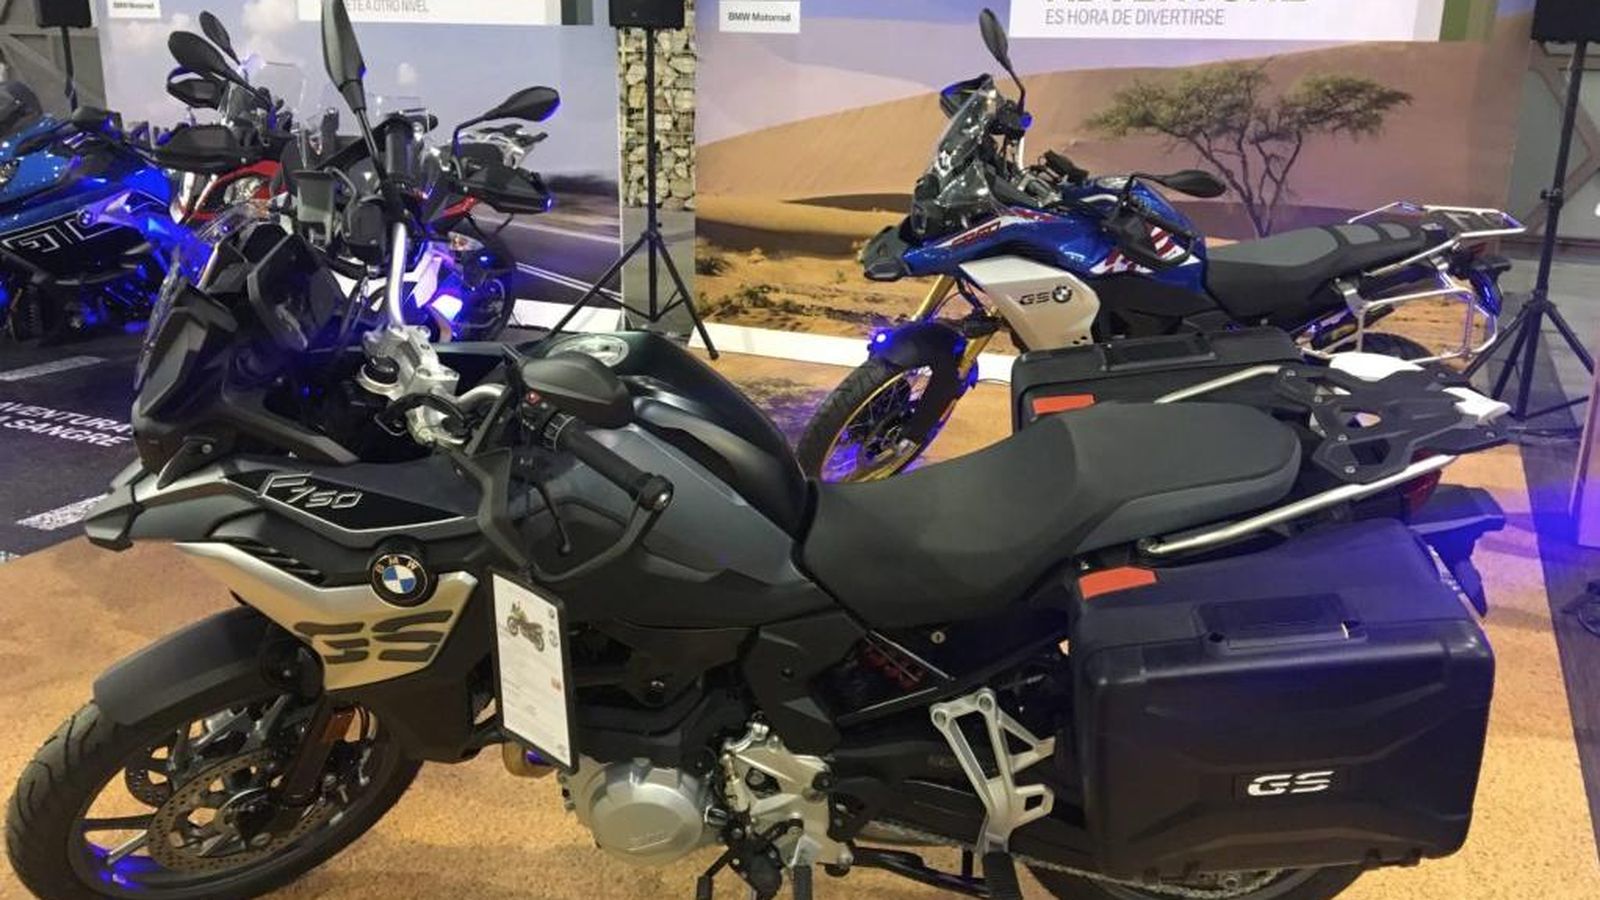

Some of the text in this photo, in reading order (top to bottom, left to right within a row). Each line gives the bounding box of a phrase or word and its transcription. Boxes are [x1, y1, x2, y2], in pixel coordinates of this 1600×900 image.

[728, 12, 791, 21] BMW Motorrad
[1045, 8, 1225, 26] ES HORA DE DIVERTIRSE
[1020, 291, 1050, 305] GS
[374, 556, 418, 574] BMW
[294, 610, 453, 664] GS
[1247, 770, 1335, 796] GS
